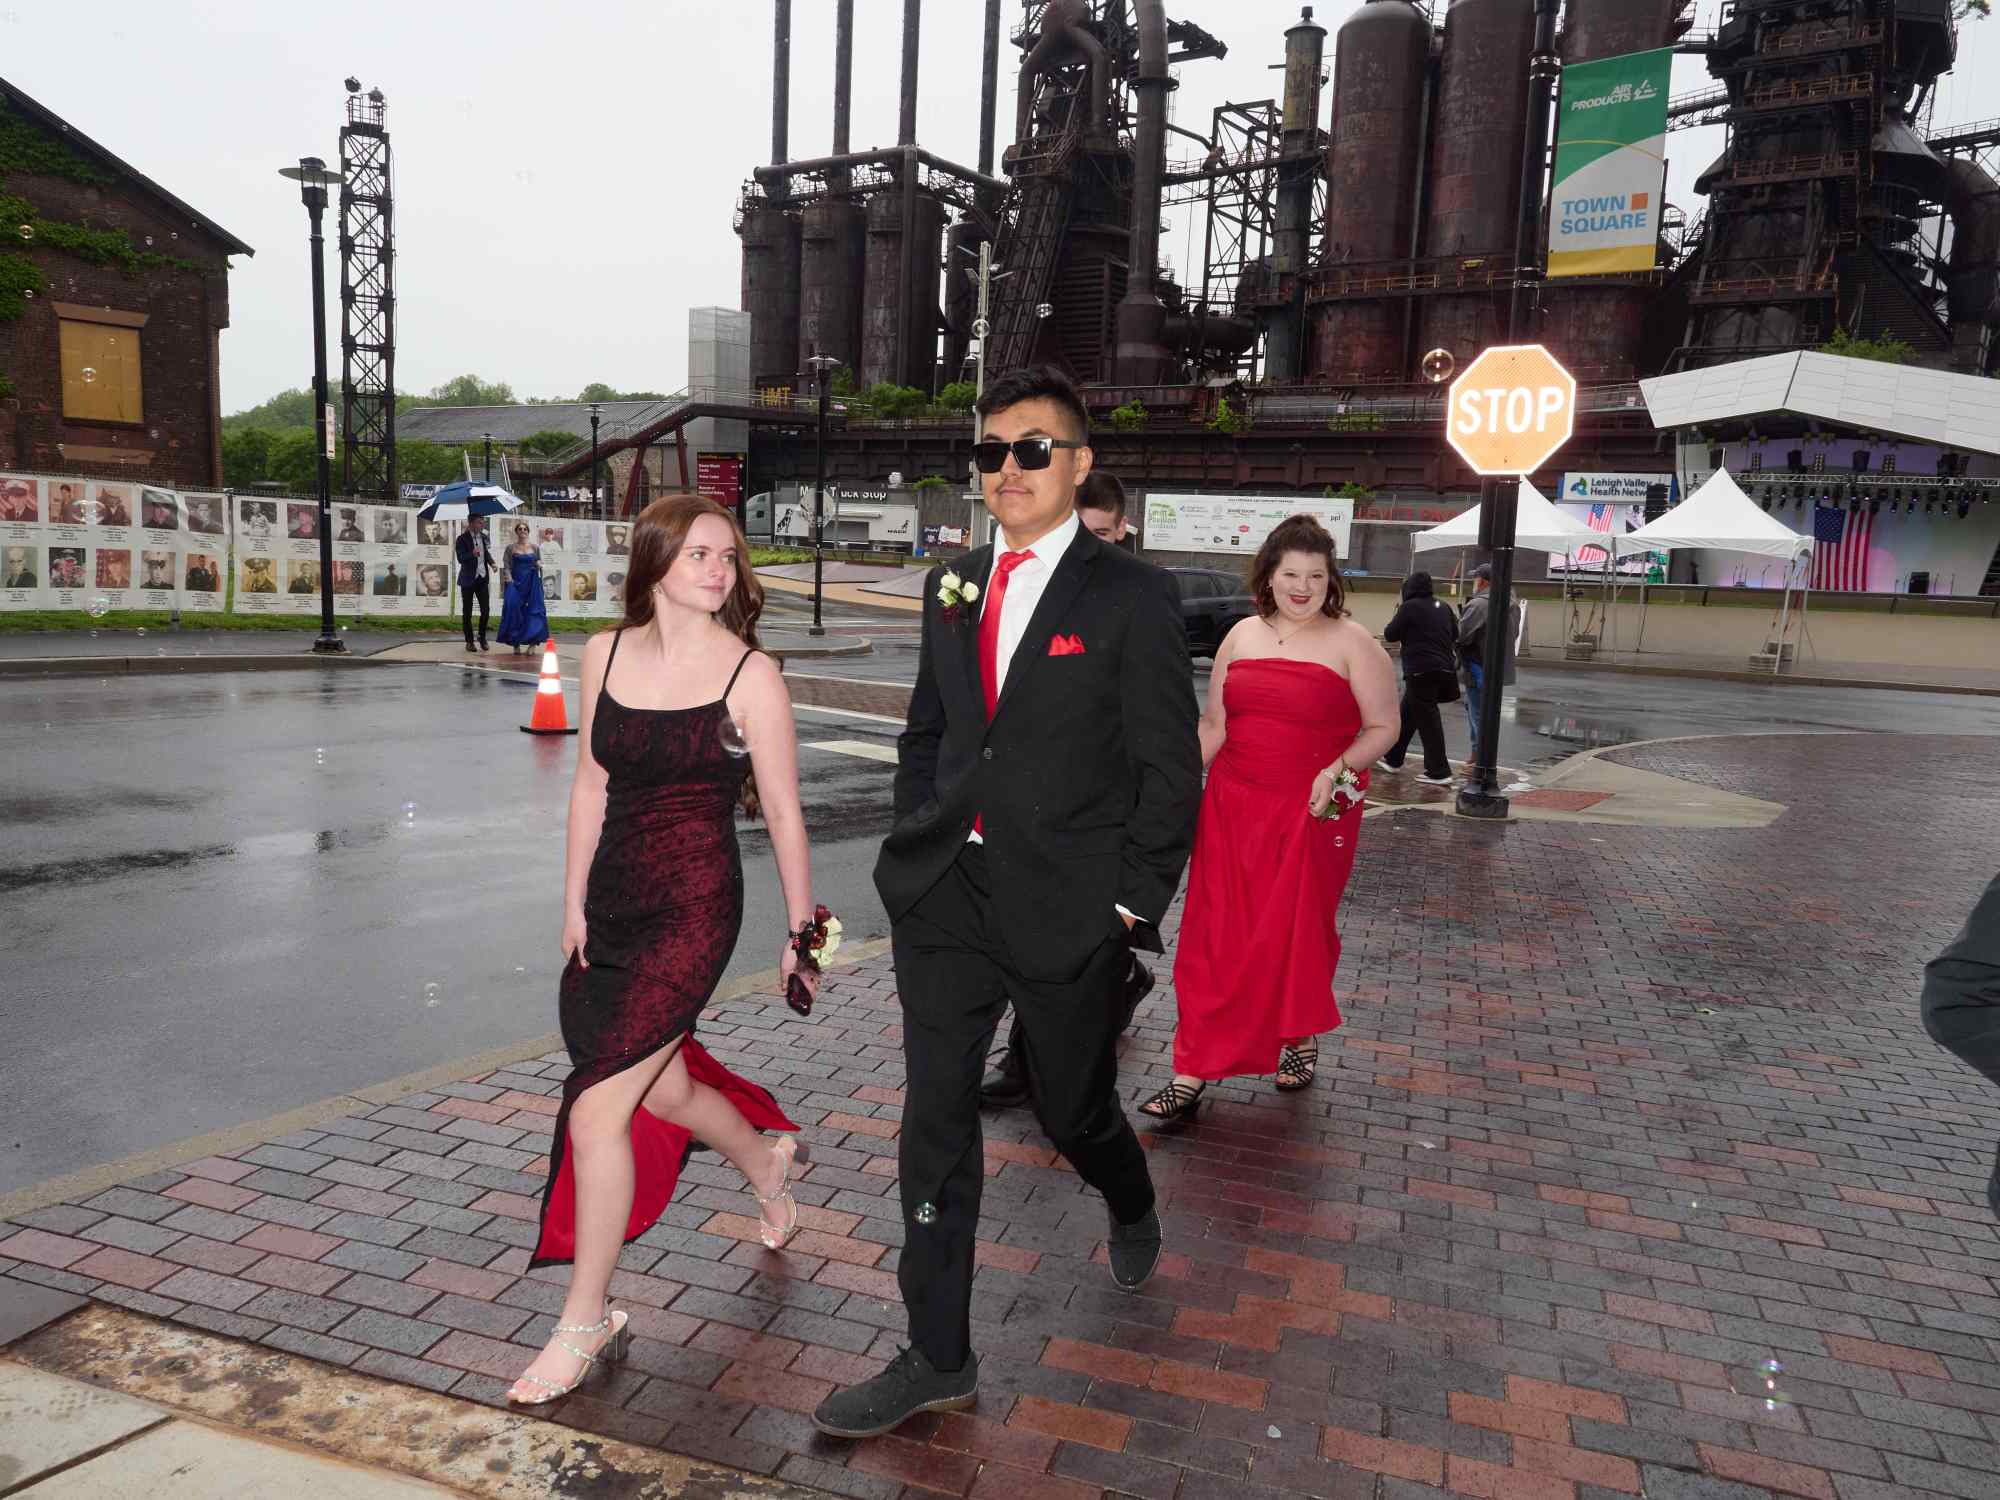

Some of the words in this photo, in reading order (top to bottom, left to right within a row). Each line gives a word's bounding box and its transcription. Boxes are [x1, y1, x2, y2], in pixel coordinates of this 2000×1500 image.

[1611, 84, 1632, 95] AIR
[1571, 94, 1632, 111] PRODUCTS
[1562, 195, 1626, 215] TOWN
[1560, 212, 1648, 235] SQUARE
[1456, 386, 1565, 435] STOP
[1592, 478, 1622, 488] Lehigh
[1624, 479, 1652, 488] Valley
[830, 486, 859, 498] Tuck
[1591, 487, 1620, 496] Health
[1622, 488, 1647, 496] Netw
